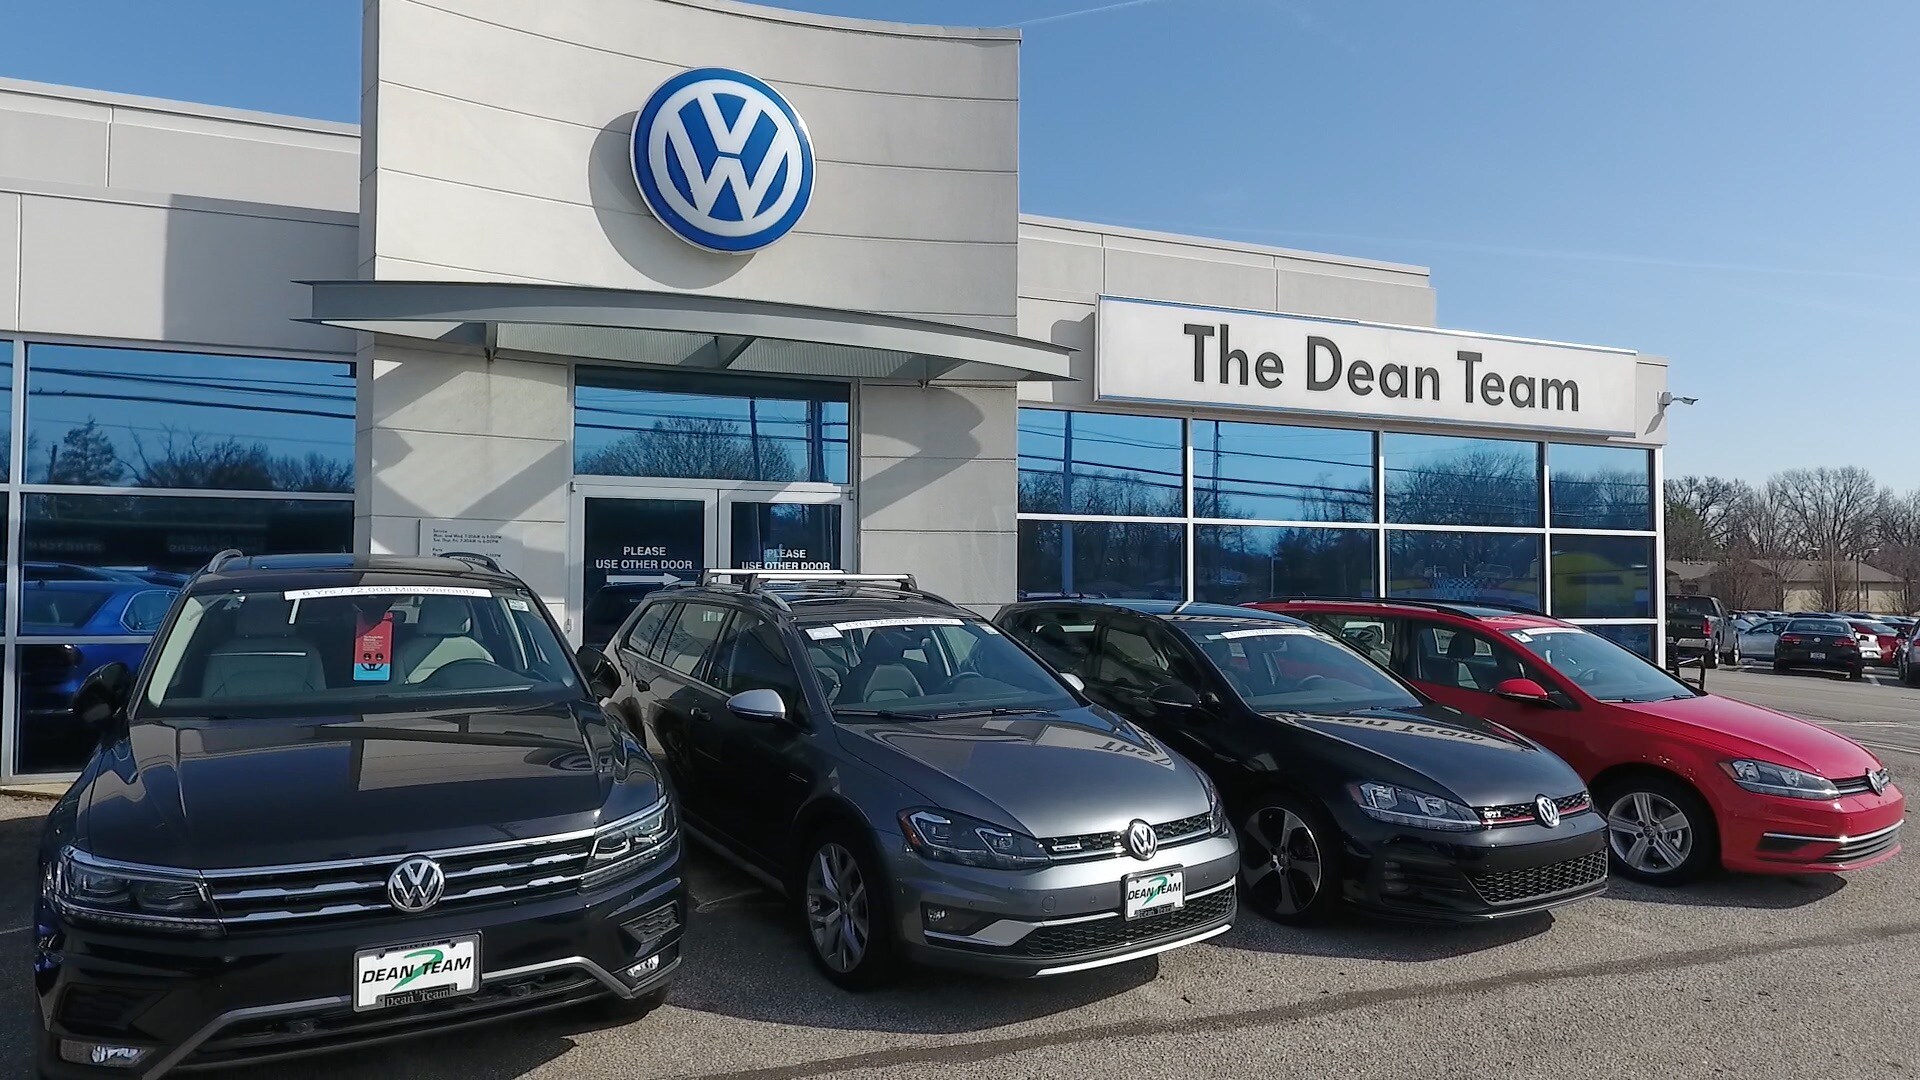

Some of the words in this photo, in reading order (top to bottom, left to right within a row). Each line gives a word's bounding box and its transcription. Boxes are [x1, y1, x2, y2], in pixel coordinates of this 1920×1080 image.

[1184, 324, 1285, 389] The
[1307, 336, 1440, 402] Dean
[1458, 351, 1579, 412] Team
[623, 546, 667, 556] PLEASE
[766, 549, 806, 559] PLEASE
[595, 559, 618, 569] USE
[620, 559, 659, 570] OTHER
[661, 560, 693, 570] DOOR
[741, 561, 763, 570] USE
[764, 561, 798, 571] OTHER
[799, 562, 831, 571] DOOR
[423, 587, 475, 595] Warranty
[1128, 887, 1154, 900] DEAN
[1157, 882, 1181, 895] TEAM
[362, 965, 415, 984] DEAN
[422, 957, 472, 975] TEAM
[386, 995, 415, 1007] Dean
[420, 989, 450, 1002] Team
